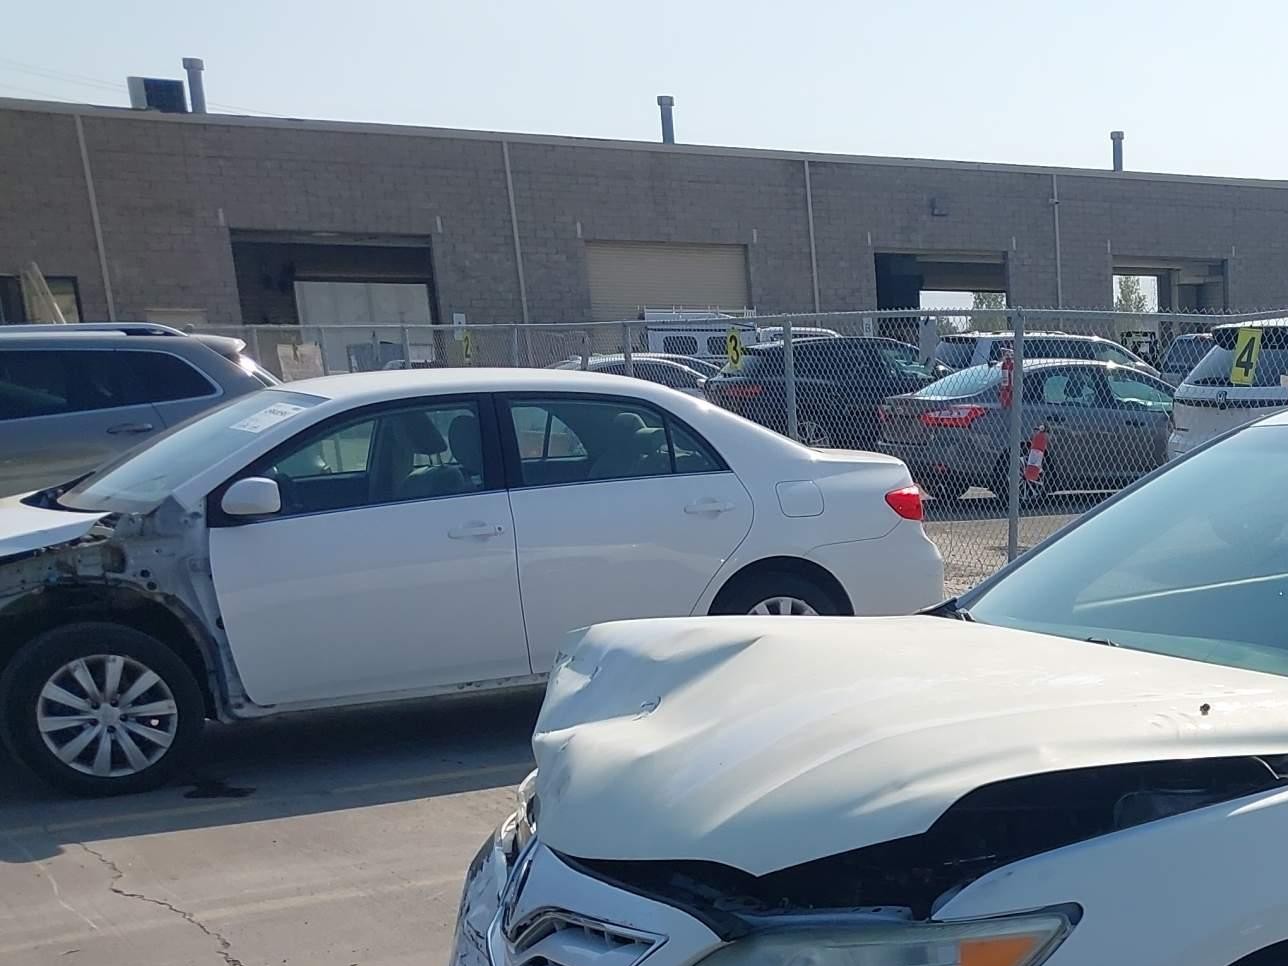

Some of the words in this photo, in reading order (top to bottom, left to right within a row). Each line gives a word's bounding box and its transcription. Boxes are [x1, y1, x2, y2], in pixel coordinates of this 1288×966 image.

[464, 335, 472, 359] 2
[729, 334, 740, 365] 3
[1235, 336, 1256, 377] 4
